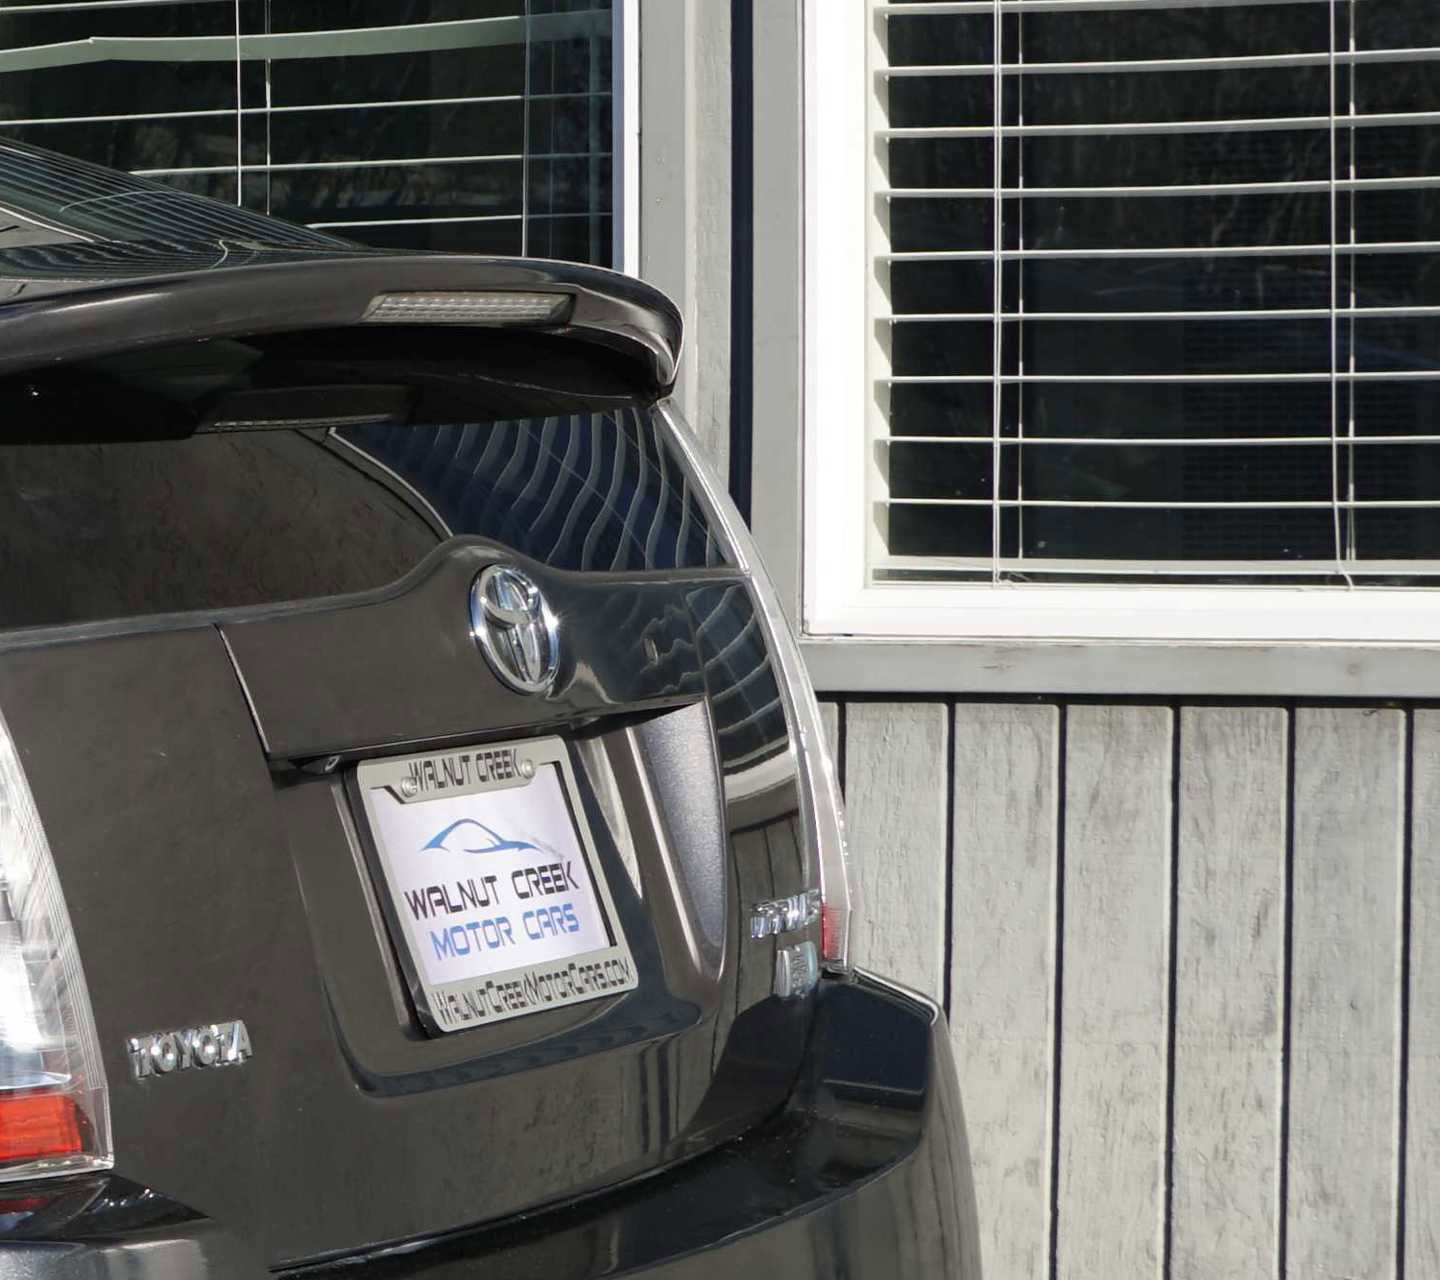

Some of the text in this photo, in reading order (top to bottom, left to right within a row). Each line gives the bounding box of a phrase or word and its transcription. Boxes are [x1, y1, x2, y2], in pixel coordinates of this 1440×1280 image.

[409, 748, 522, 792] WALNUT CREEK
[404, 860, 580, 920] WALNUT CREEK
[430, 903, 580, 959] MOTOR CARS
[127, 1019, 254, 1079] TOYOTA
